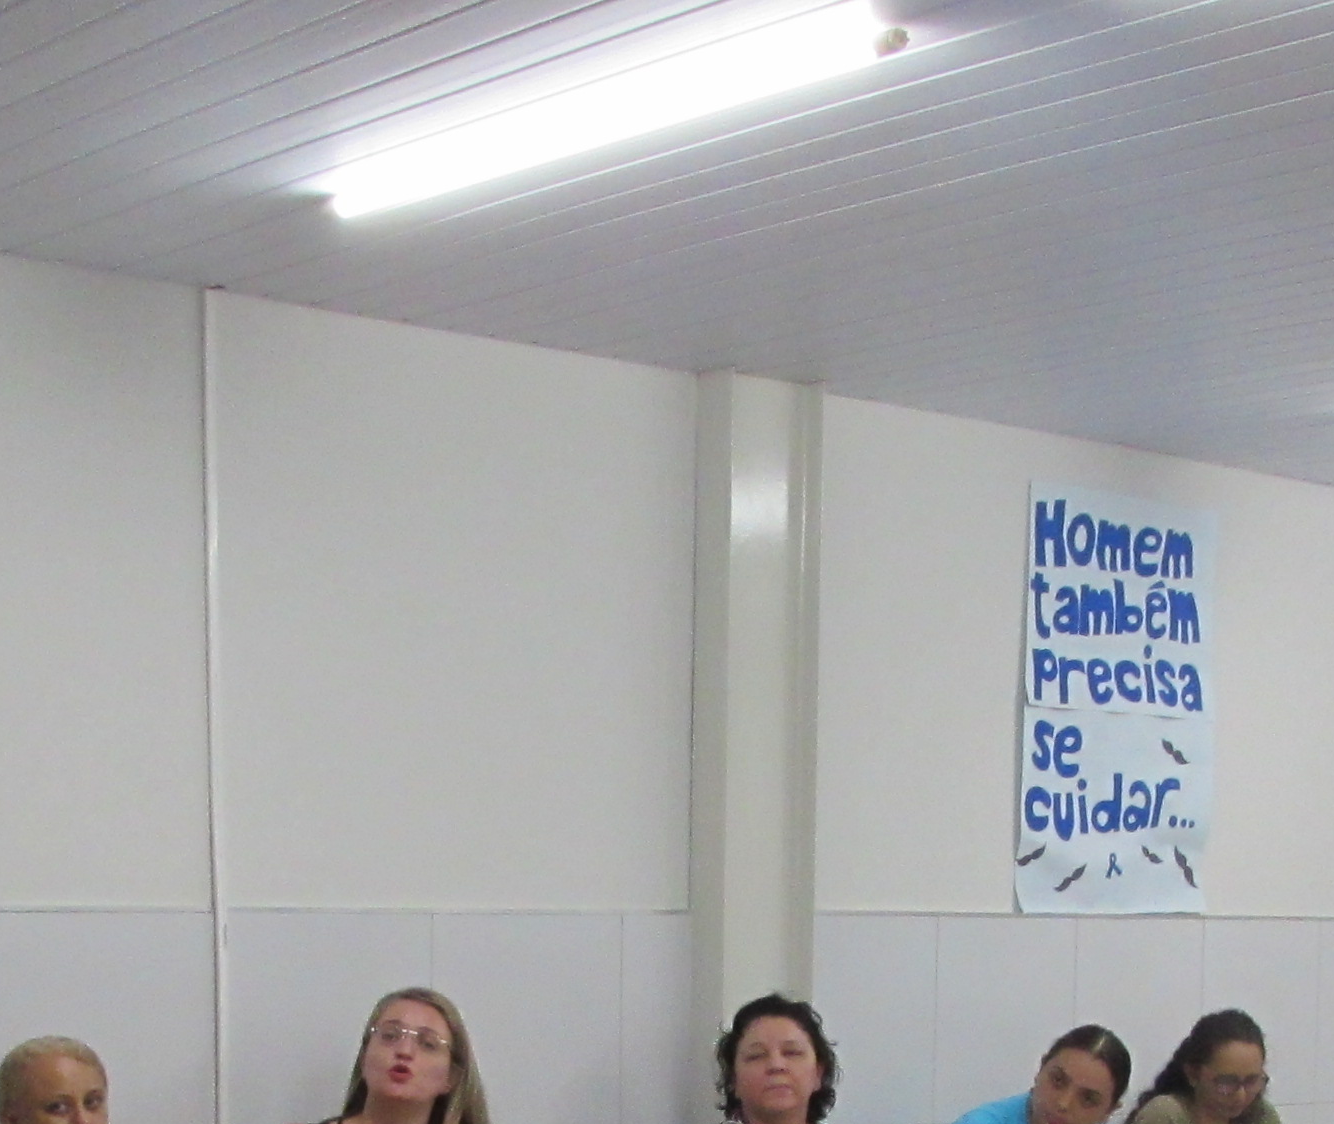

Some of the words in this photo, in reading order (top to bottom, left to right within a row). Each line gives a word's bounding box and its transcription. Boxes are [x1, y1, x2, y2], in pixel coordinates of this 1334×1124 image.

[1035, 499, 1195, 578] Homem
[1031, 572, 1201, 643] também
[1033, 645, 1204, 712] precisa
[1032, 719, 1084, 778] se
[1024, 773, 1196, 841] cuidar...
